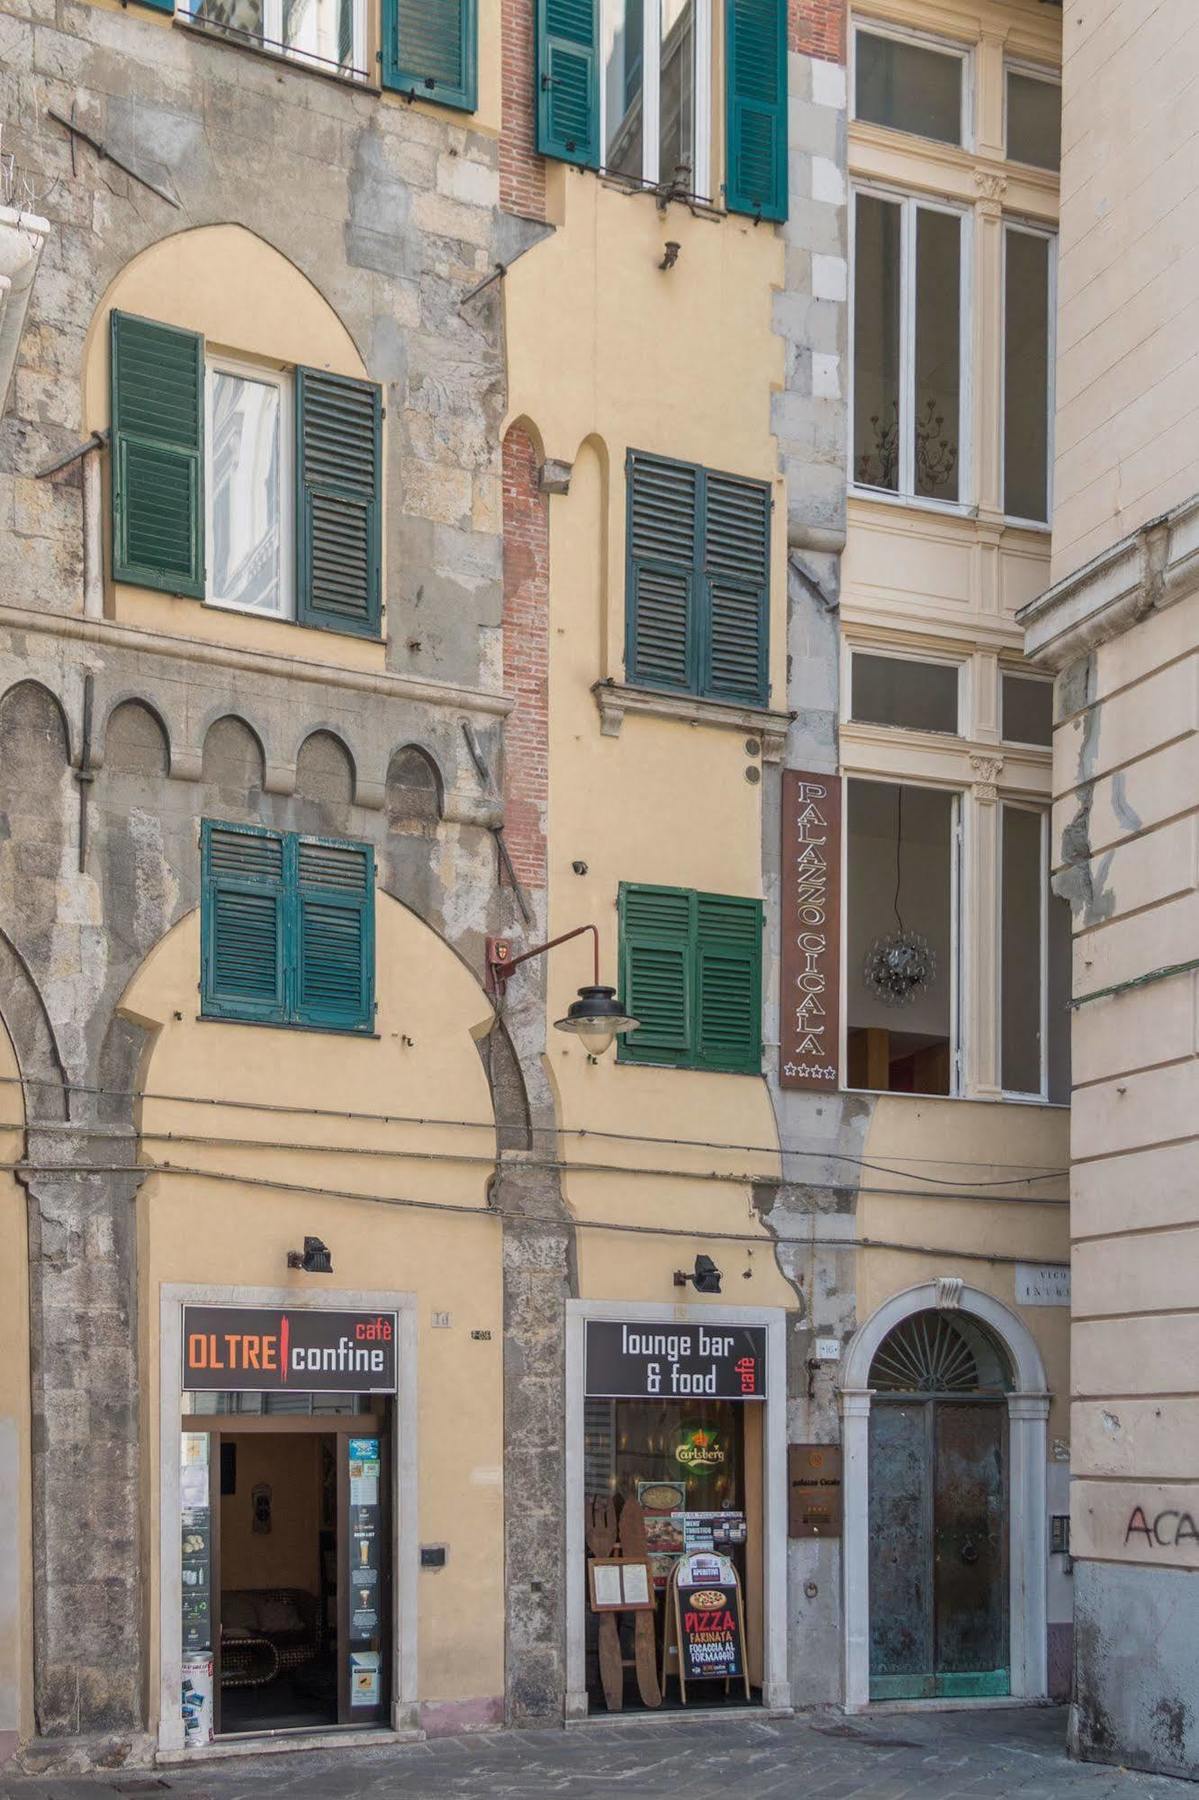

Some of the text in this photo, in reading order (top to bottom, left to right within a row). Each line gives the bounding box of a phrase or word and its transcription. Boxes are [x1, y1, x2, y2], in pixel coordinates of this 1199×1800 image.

[795, 781, 827, 1056] PALAZZO CICALA
[1040, 1271, 1067, 1279] VICO
[355, 1316, 392, 1341] cafè
[189, 1333, 384, 1372] OLTRE confine
[622, 1324, 735, 1362] lounge bar
[647, 1363, 717, 1393] & food
[734, 1357, 756, 1393] cafè
[675, 1444, 725, 1463] Carlsberg
[685, 1610, 736, 1633] PIZZA
[689, 1641, 736, 1653] FOCACCIA AL
[690, 1631, 733, 1643] FARINATA
[691, 1651, 735, 1664] FORMAGGIO
